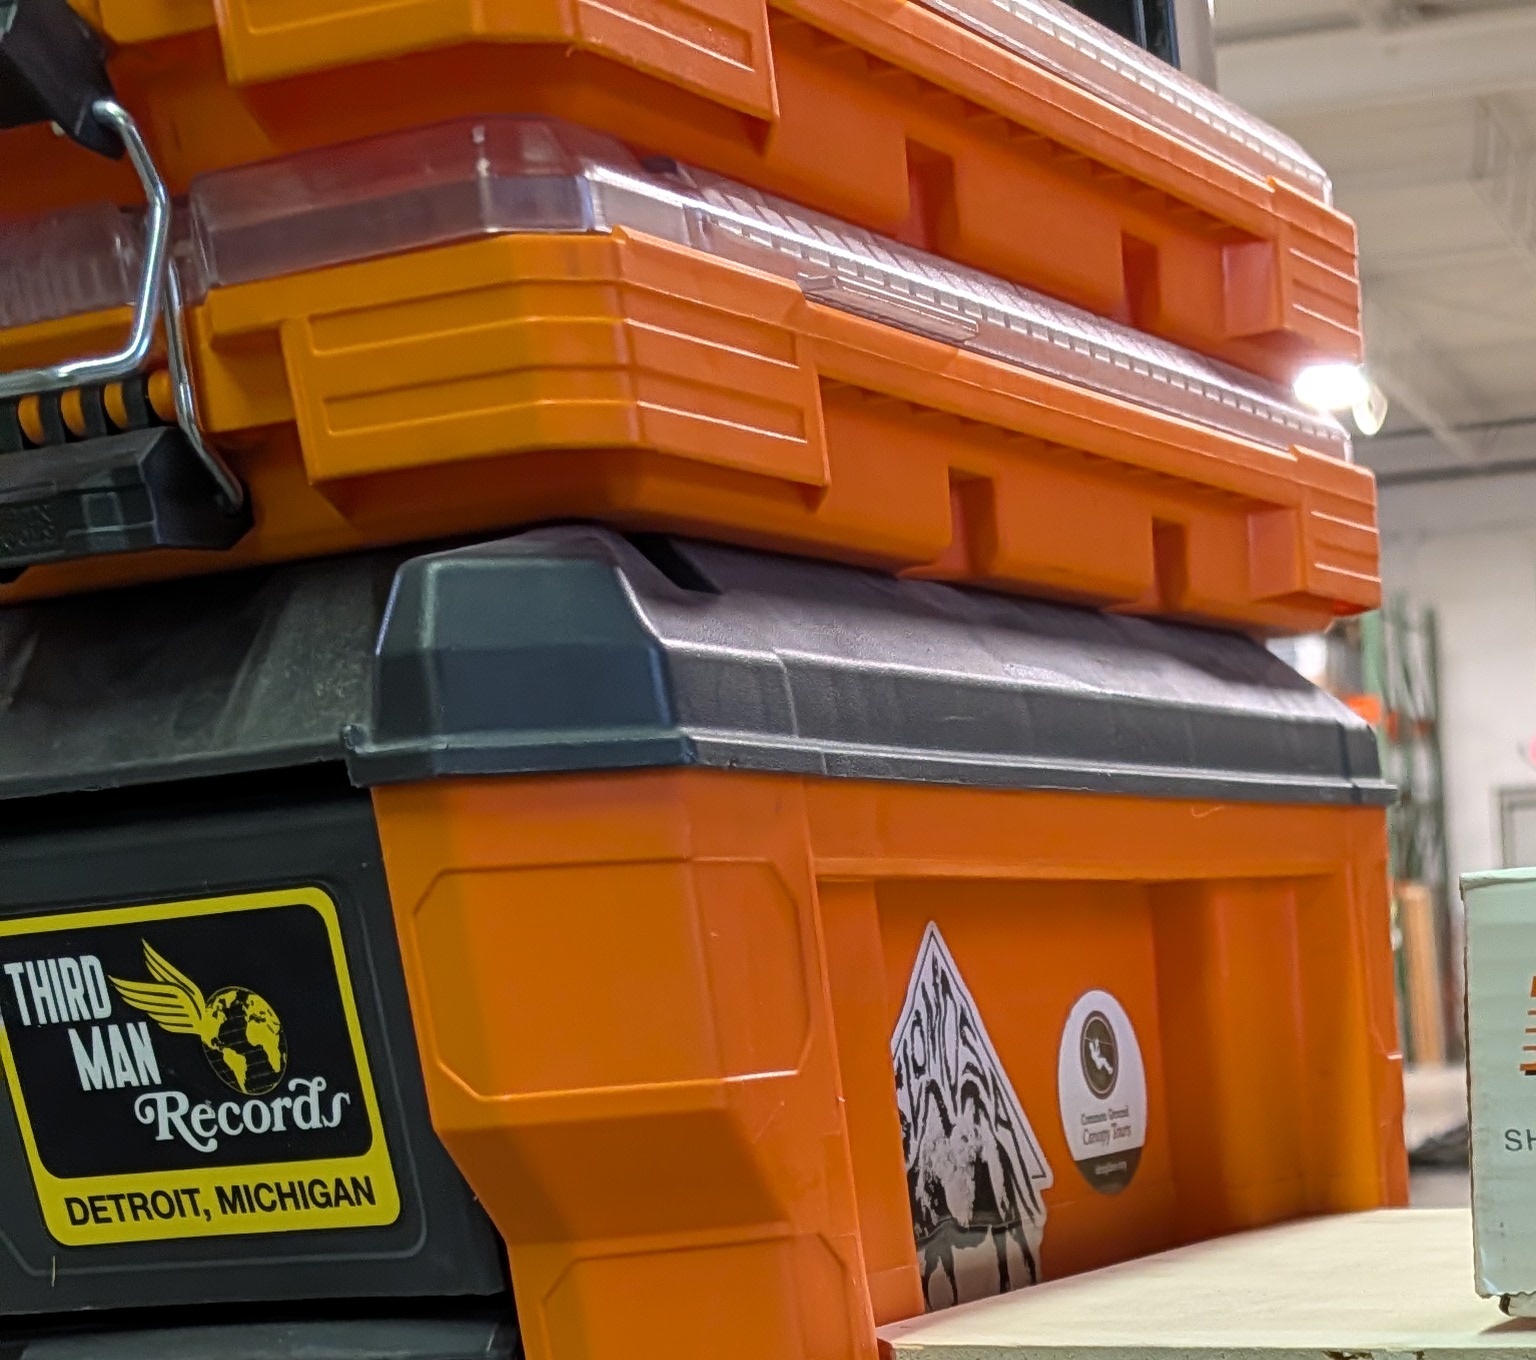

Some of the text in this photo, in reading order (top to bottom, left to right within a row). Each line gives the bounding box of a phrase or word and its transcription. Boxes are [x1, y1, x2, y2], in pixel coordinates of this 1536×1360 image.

[4, 954, 112, 1027] THIRD
[68, 1021, 162, 1092] MAN
[134, 1076, 351, 1153] Records
[65, 1175, 377, 1226] DETROIT, MICHIGAN
